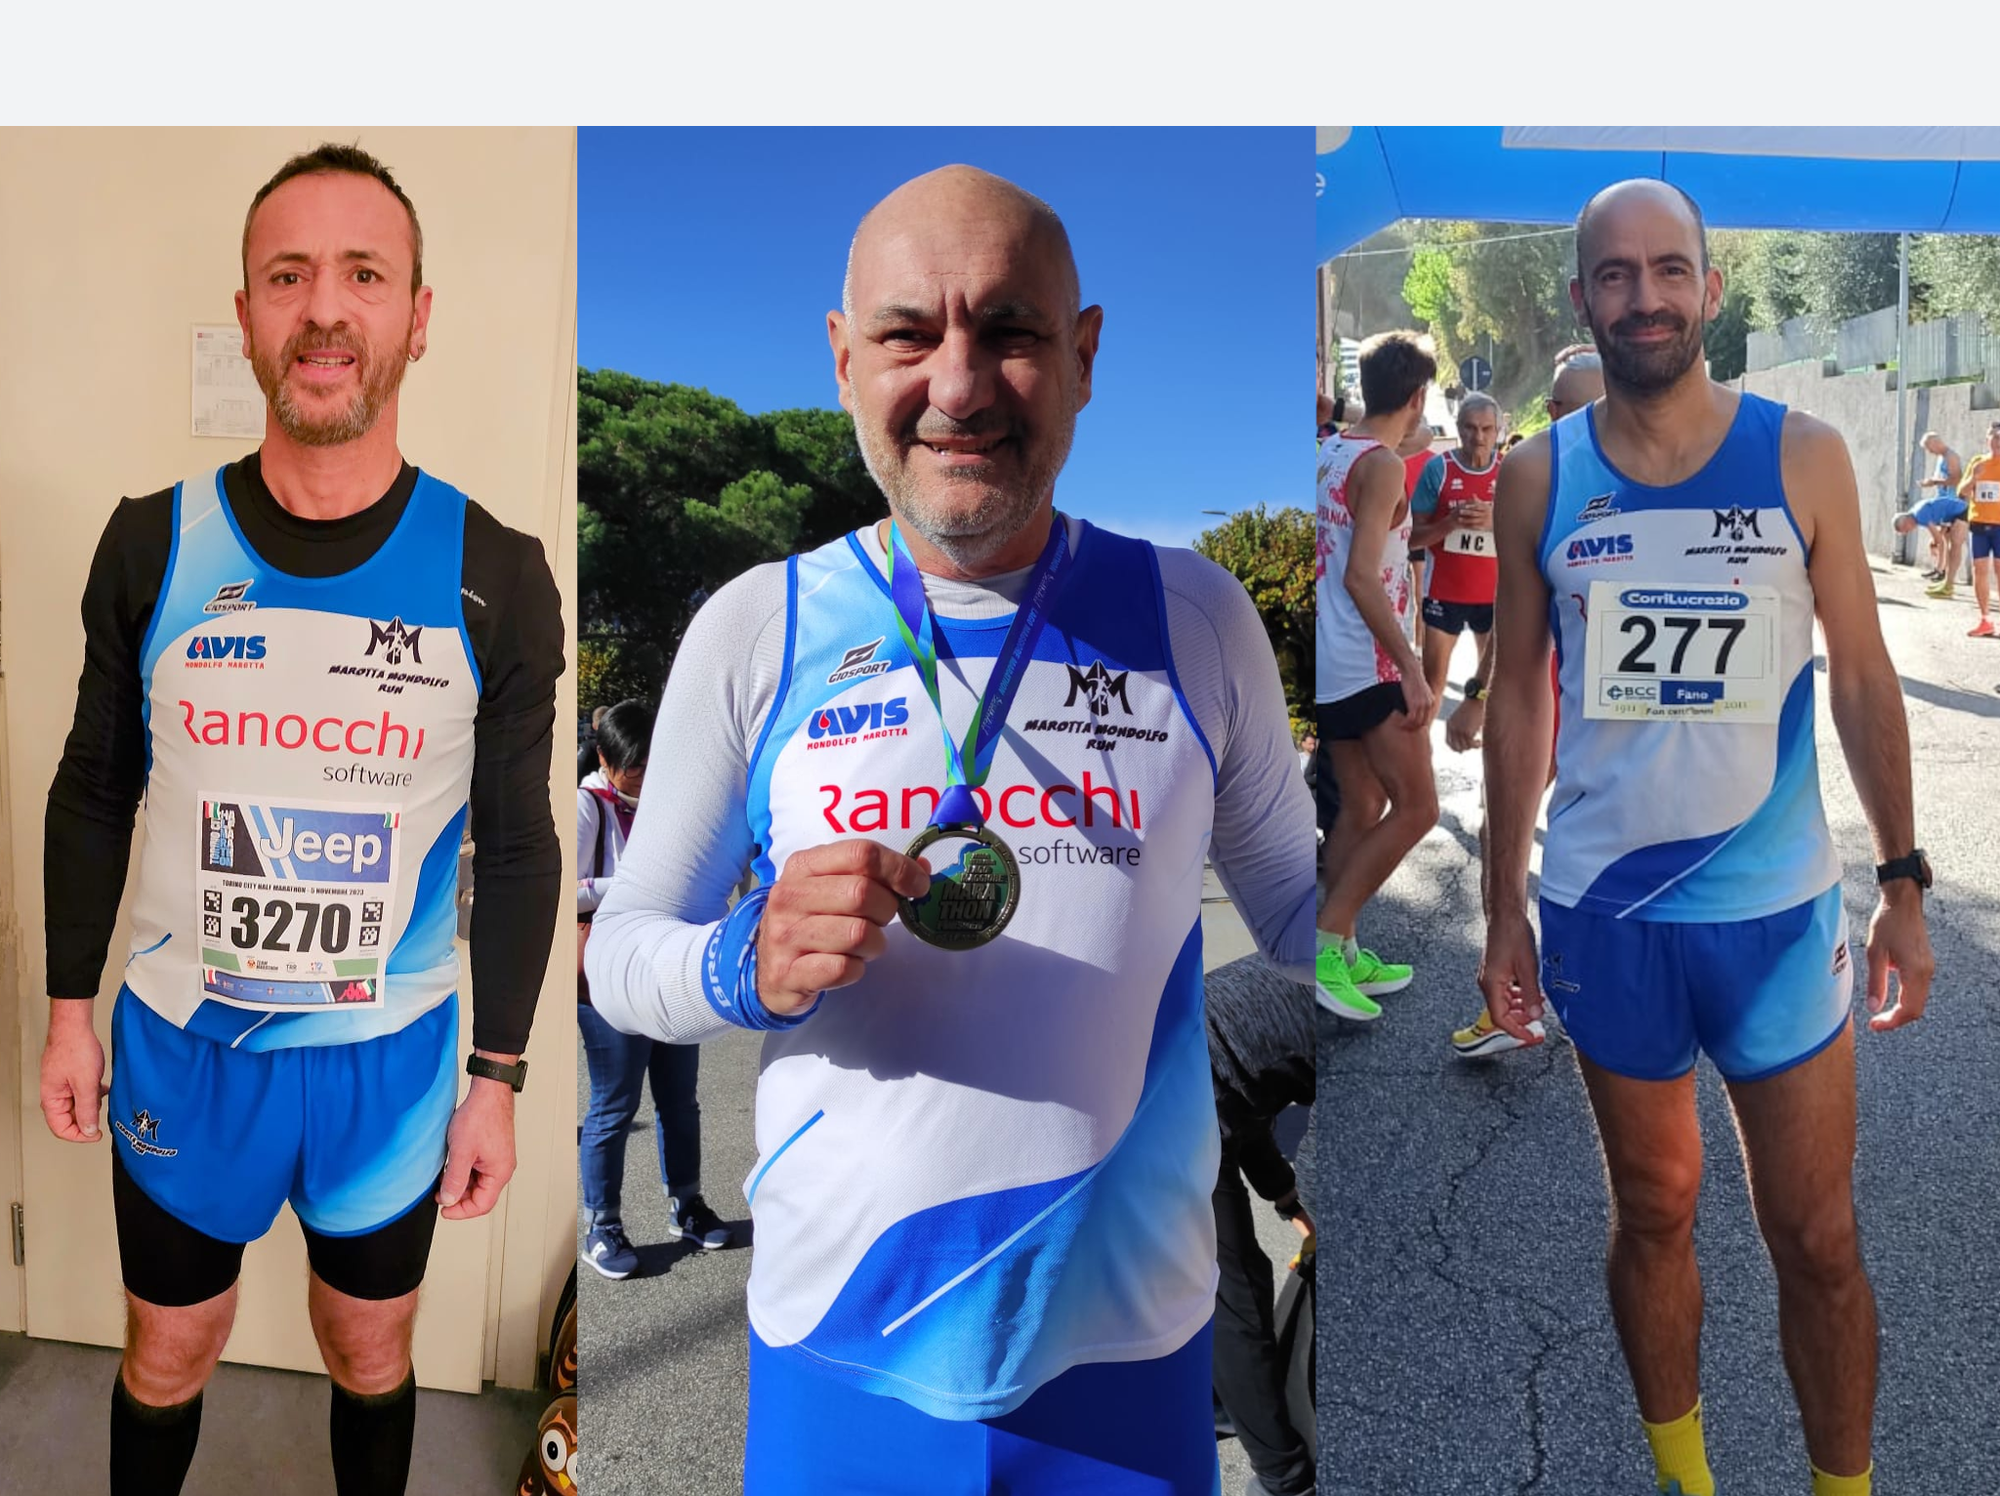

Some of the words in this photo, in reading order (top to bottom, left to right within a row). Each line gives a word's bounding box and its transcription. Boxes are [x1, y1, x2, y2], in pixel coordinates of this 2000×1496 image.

[1567, 534, 1633, 560] AVIS
[1685, 546, 1731, 556] MAROTTA
[1726, 556, 1749, 564] RUN
[1627, 592, 1741, 606] CorriLucrezia
[186, 635, 267, 660] AVIS
[1617, 615, 1746, 675] 277
[185, 661, 222, 669] MONDOLFO
[227, 661, 265, 669] MAROTTA
[828, 662, 889, 683] GIOSPORT
[328, 665, 385, 679] MAROTTA
[386, 672, 450, 688] MONDOLFO
[378, 683, 404, 695] RUN
[1625, 686, 1656, 696] BCC
[1677, 689, 1709, 700] Fano
[808, 697, 909, 740] AVIS
[178, 700, 426, 760] Ranocchi
[807, 736, 857, 750] MONDOLFO
[863, 728, 908, 741] MAROTTA
[1023, 720, 1091, 733] MAROTTA
[1095, 725, 1168, 742] MONDOLFO
[1086, 739, 1116, 751] RUN
[323, 763, 412, 787] software
[260, 818, 382, 873] Jeep
[1018, 839, 1141, 866] software
[222, 880, 242, 888] TORINO
[243, 881, 257, 890] CITY
[273, 884, 306, 893] MARATHON
[942, 883, 996, 900] MARA
[940, 900, 994, 920] THON
[231, 897, 351, 954] 3270
